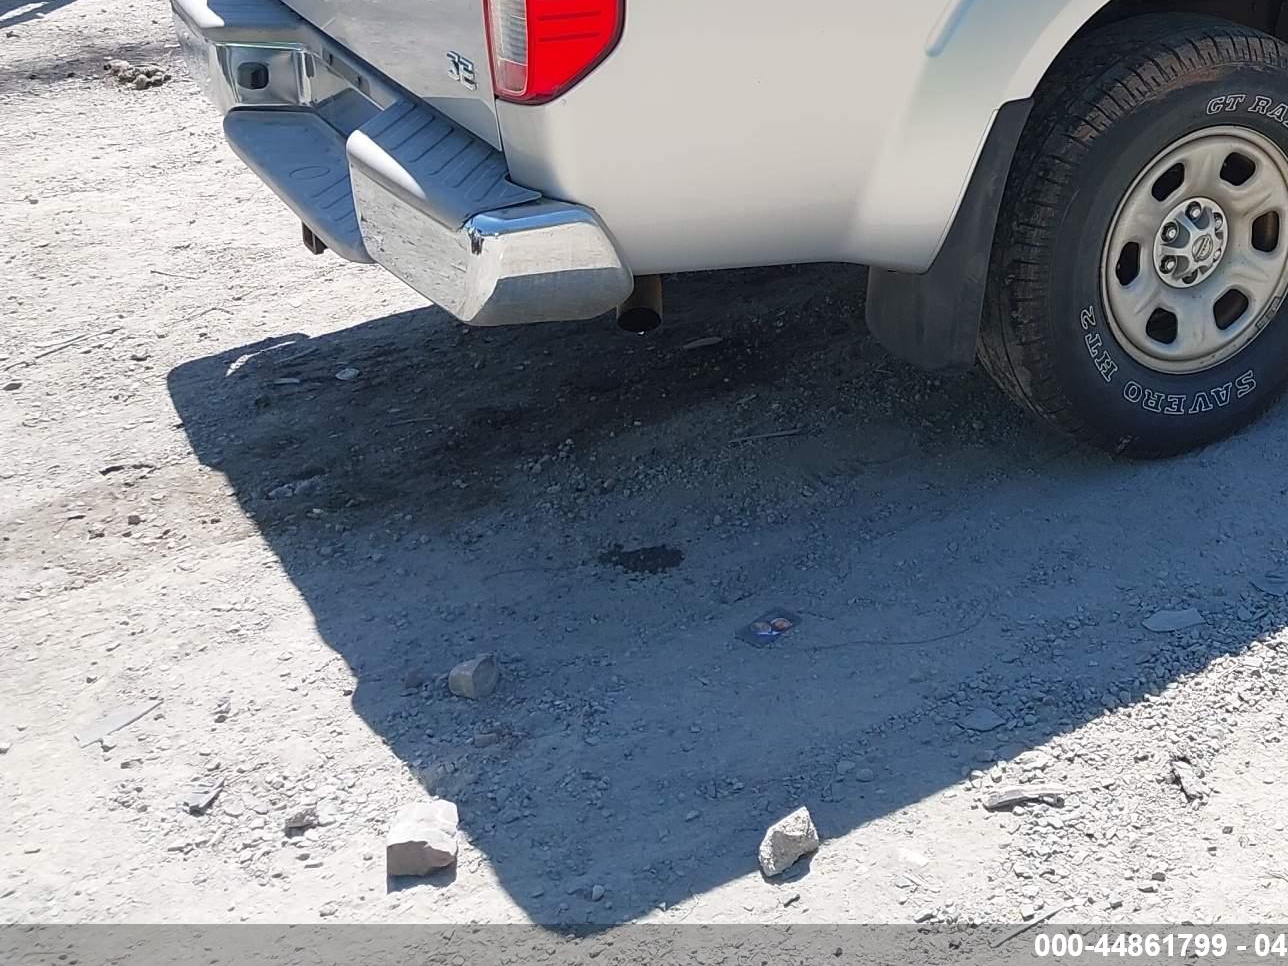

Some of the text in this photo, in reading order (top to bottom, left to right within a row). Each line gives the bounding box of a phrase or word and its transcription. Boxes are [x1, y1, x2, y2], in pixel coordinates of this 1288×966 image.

[446, 50, 478, 91] V6
[1080, 305, 1257, 415] SAVERO HT2
